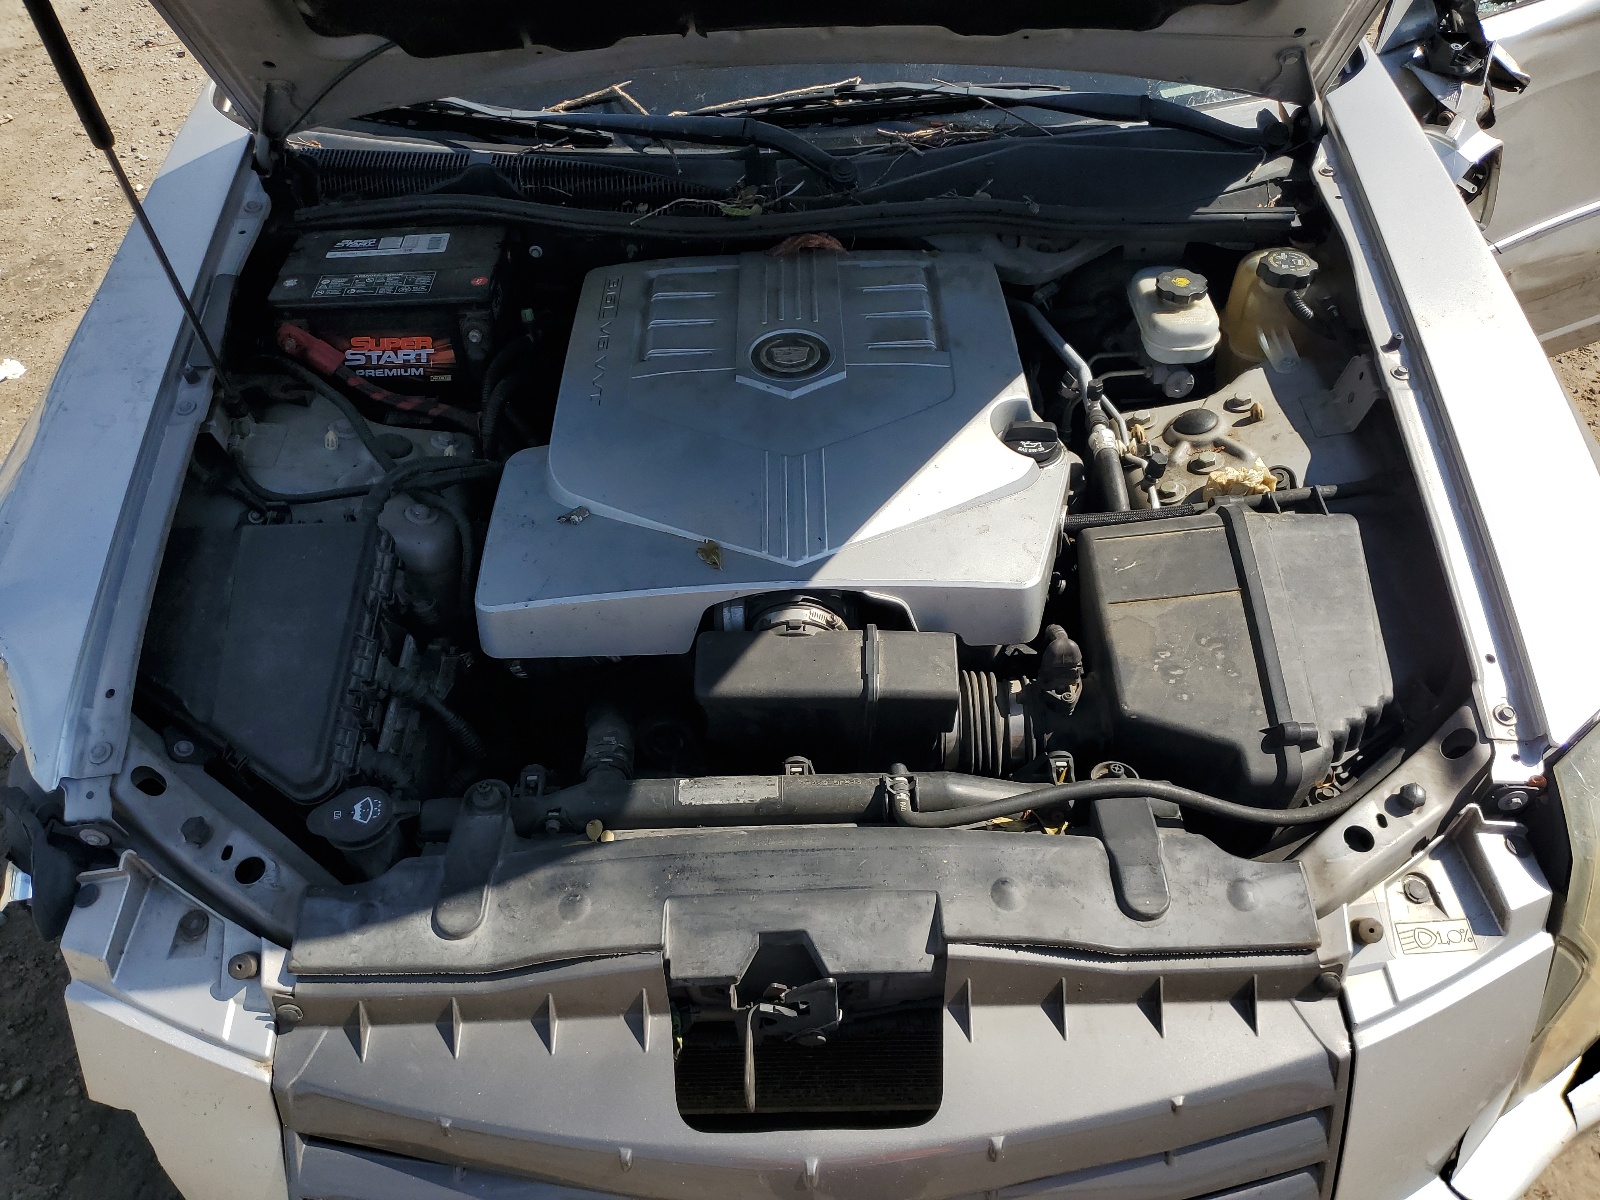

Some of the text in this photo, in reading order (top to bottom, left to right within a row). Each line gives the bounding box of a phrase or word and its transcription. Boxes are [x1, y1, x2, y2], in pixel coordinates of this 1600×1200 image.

[350, 336, 433, 350] SUPER
[597, 320, 612, 351] V6
[345, 349, 435, 366] START
[355, 367, 424, 377] PREMIUM
[590, 354, 607, 406] VVT
